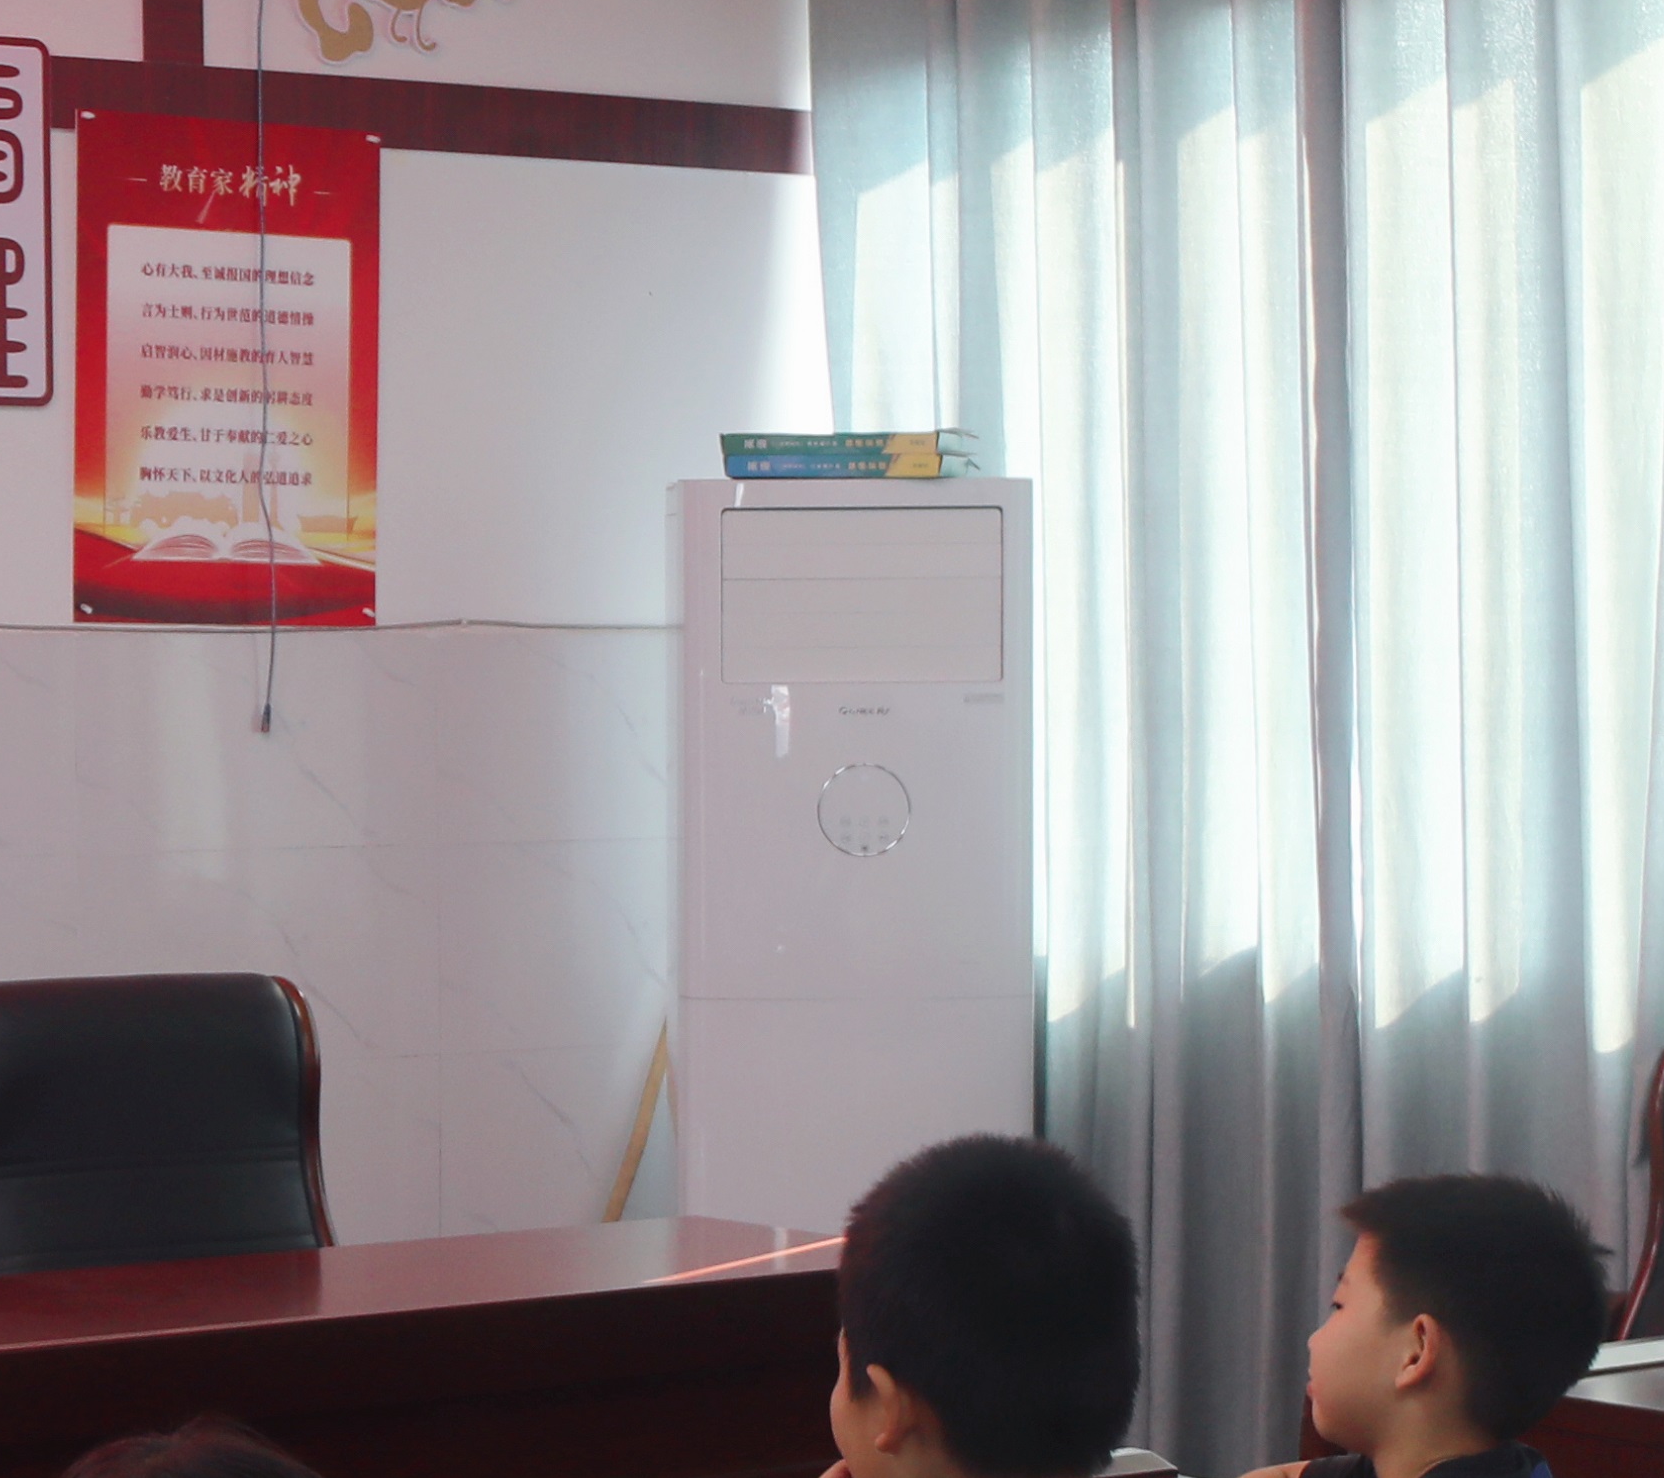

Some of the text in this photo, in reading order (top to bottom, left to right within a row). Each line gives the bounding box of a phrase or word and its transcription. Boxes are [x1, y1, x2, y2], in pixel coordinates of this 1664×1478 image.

[159, 163, 301, 207] 教育家精神
